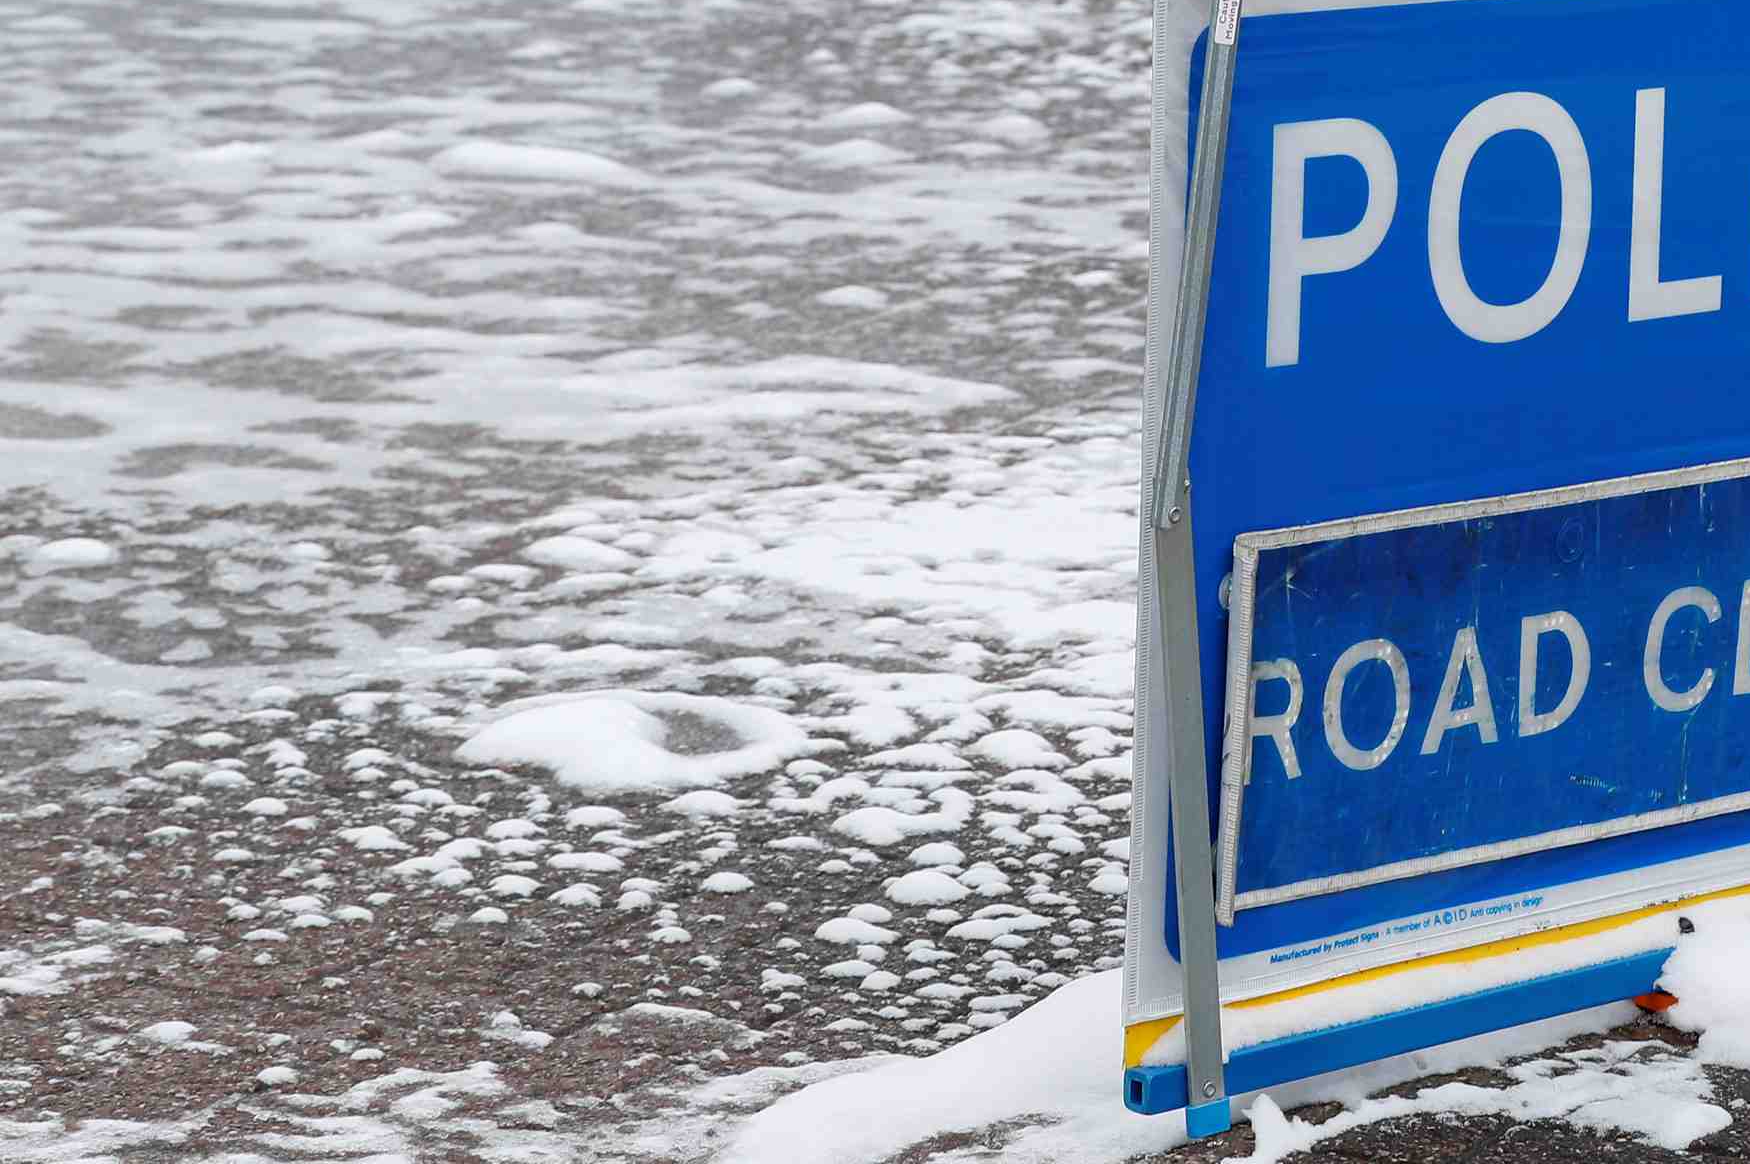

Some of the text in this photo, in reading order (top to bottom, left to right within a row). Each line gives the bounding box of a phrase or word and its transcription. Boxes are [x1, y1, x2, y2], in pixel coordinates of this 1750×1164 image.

[1225, 0, 1239, 40] Moving
[1243, 609, 1593, 786] ROAD
[1269, 943, 1323, 965] Manufactured
